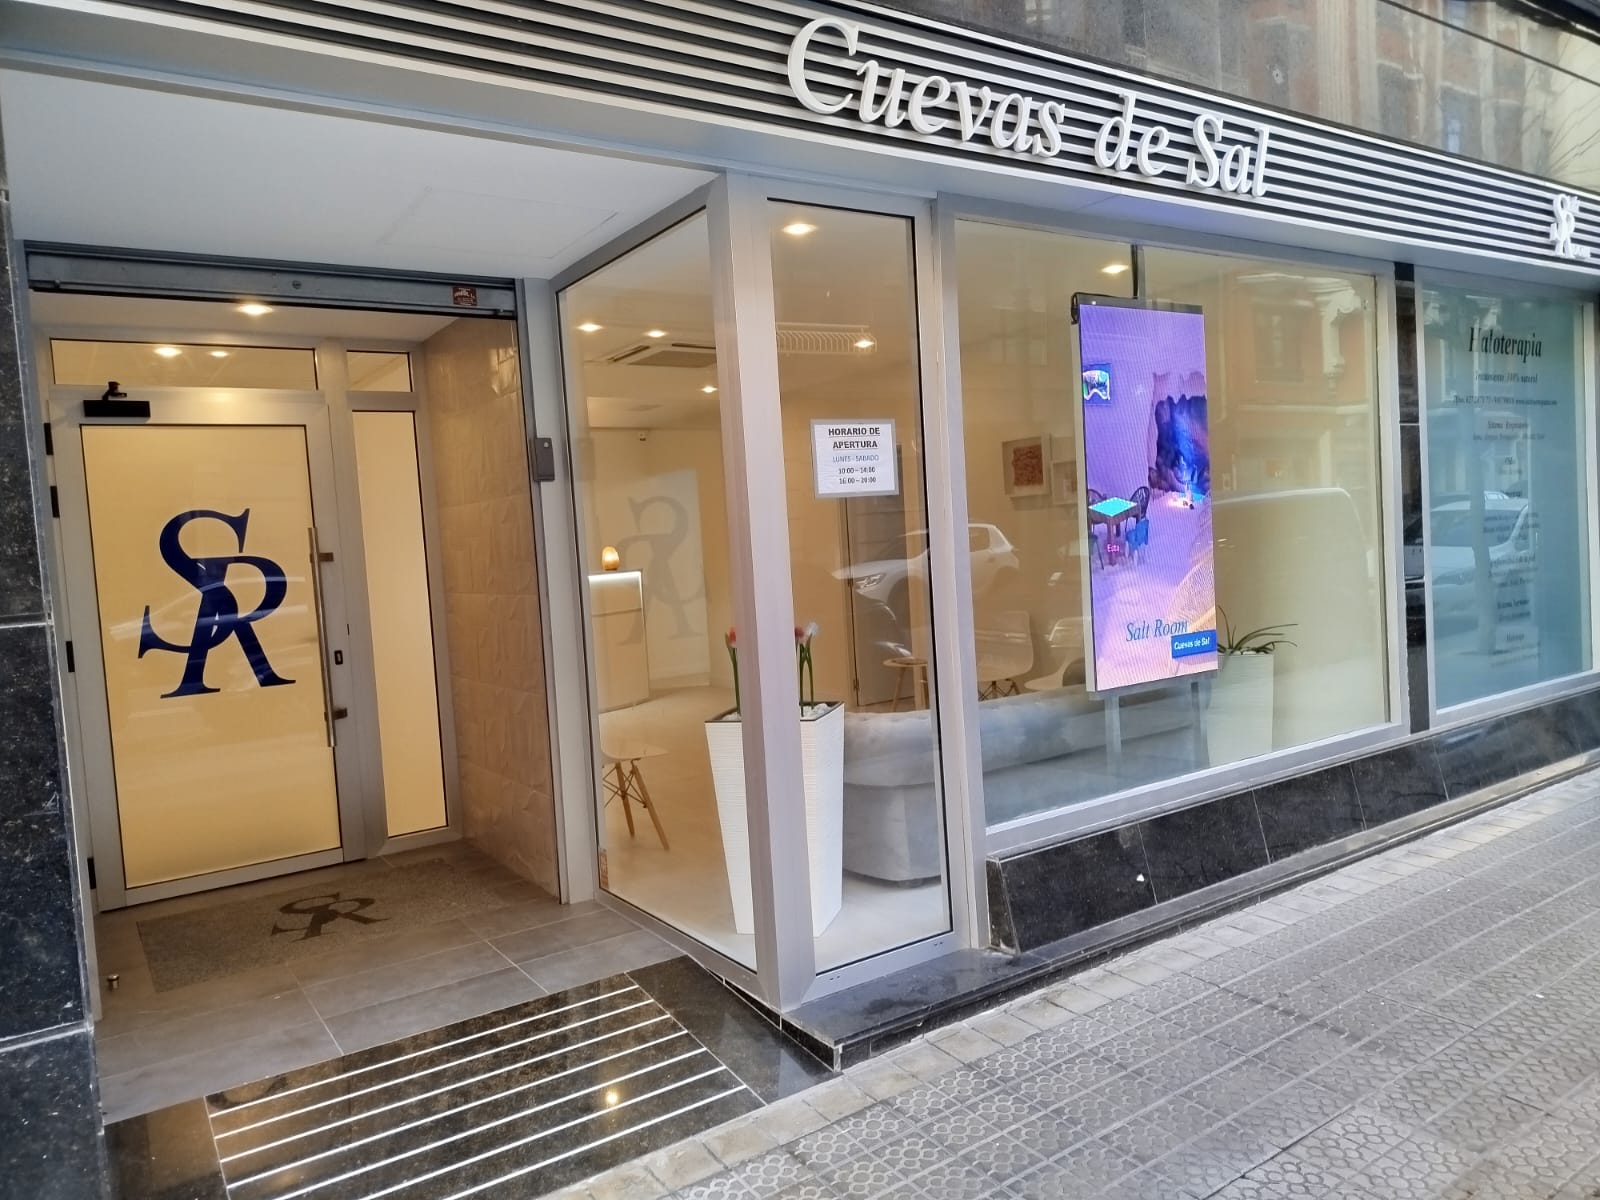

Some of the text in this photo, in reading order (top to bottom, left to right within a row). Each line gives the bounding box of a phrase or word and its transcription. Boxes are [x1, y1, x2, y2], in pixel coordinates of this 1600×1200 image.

[787, 16, 1271, 197] Cuevas de Sal
[1468, 327, 1542, 363] Haloterapia
[828, 427, 880, 436] HORARIO DE
[833, 440, 878, 449] APERTURA
[833, 455, 851, 463] LUNES
[1126, 618, 1188, 642] Salt Room
[1174, 637, 1210, 650] Cuevas de Sal
